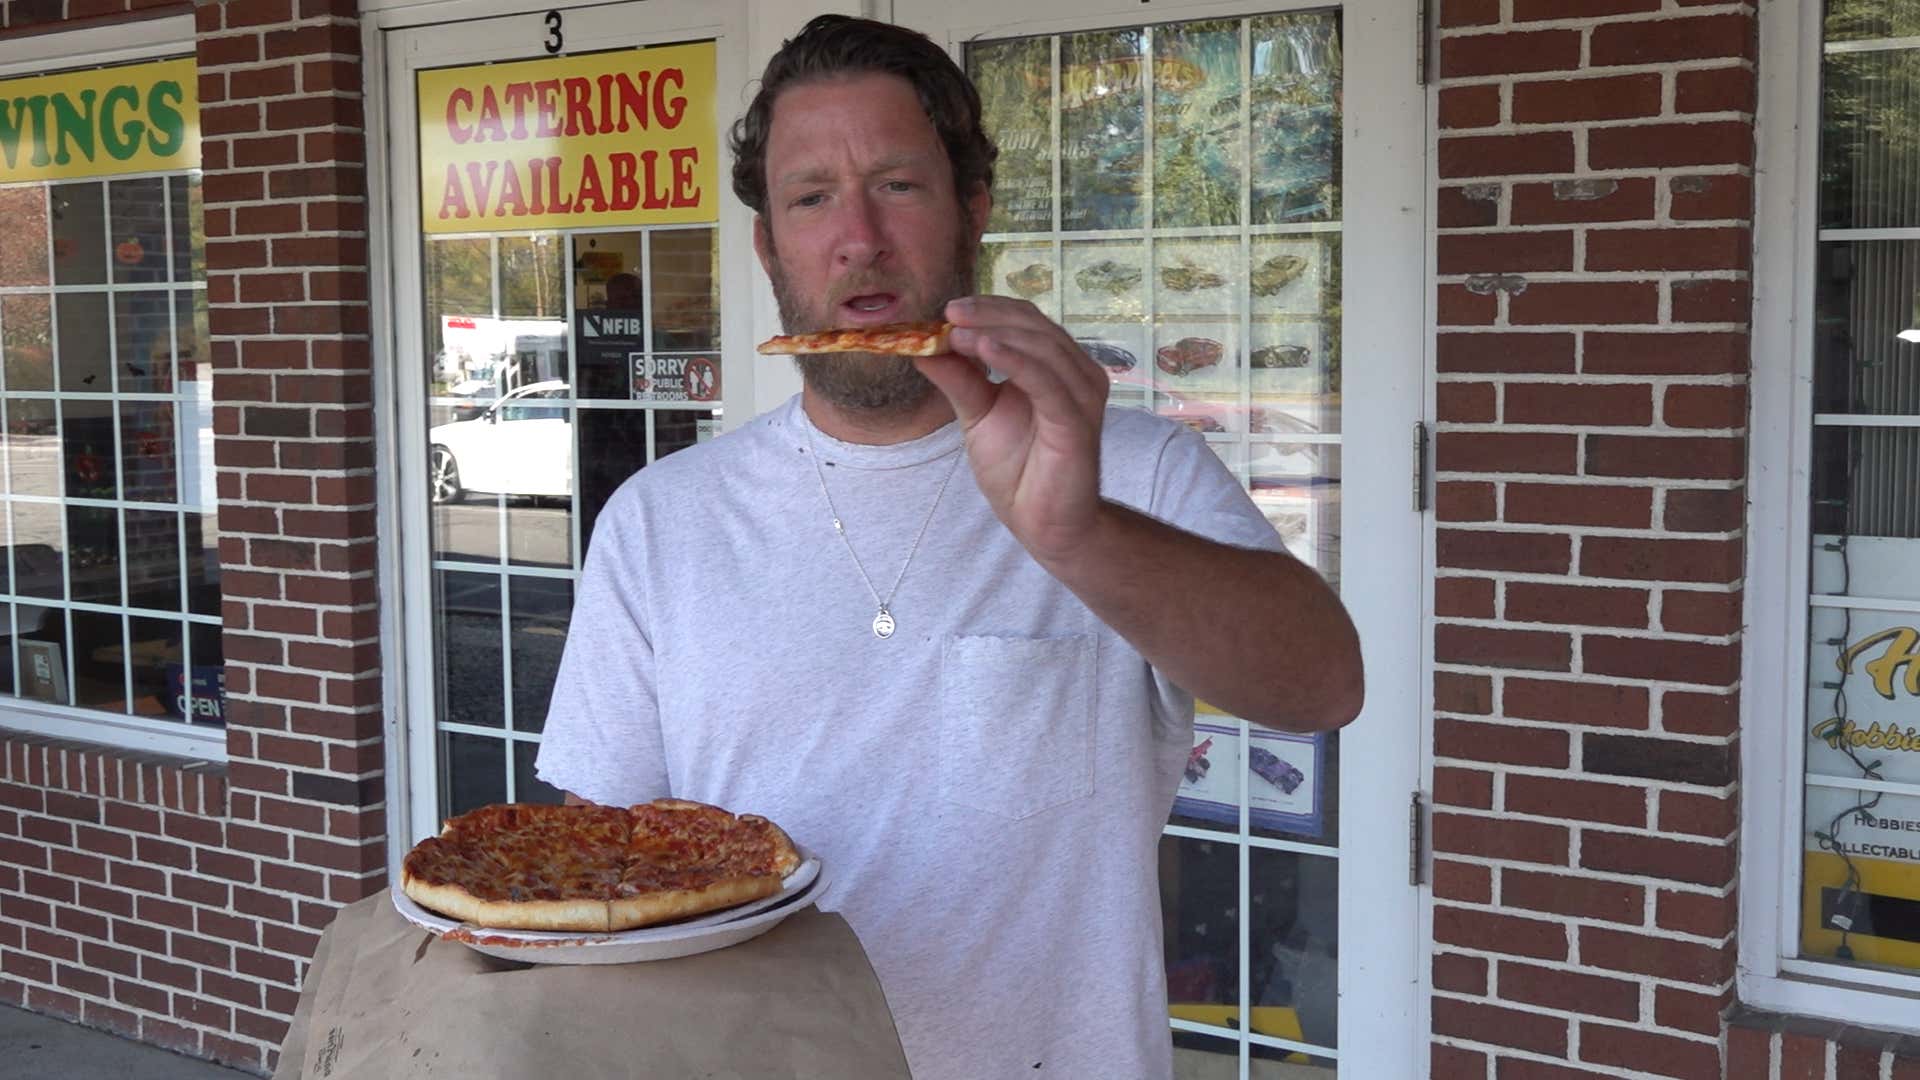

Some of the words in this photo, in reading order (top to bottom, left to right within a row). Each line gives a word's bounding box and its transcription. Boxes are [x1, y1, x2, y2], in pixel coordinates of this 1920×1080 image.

[544, 11, 563, 54] 3
[446, 67, 688, 145] CATERING
[439, 146, 701, 220] AVAILABLE
[602, 317, 641, 336] NFIB
[635, 358, 688, 376] SORRY
[177, 694, 221, 717] OPEN
[1819, 838, 1920, 861] CLLECTABL
